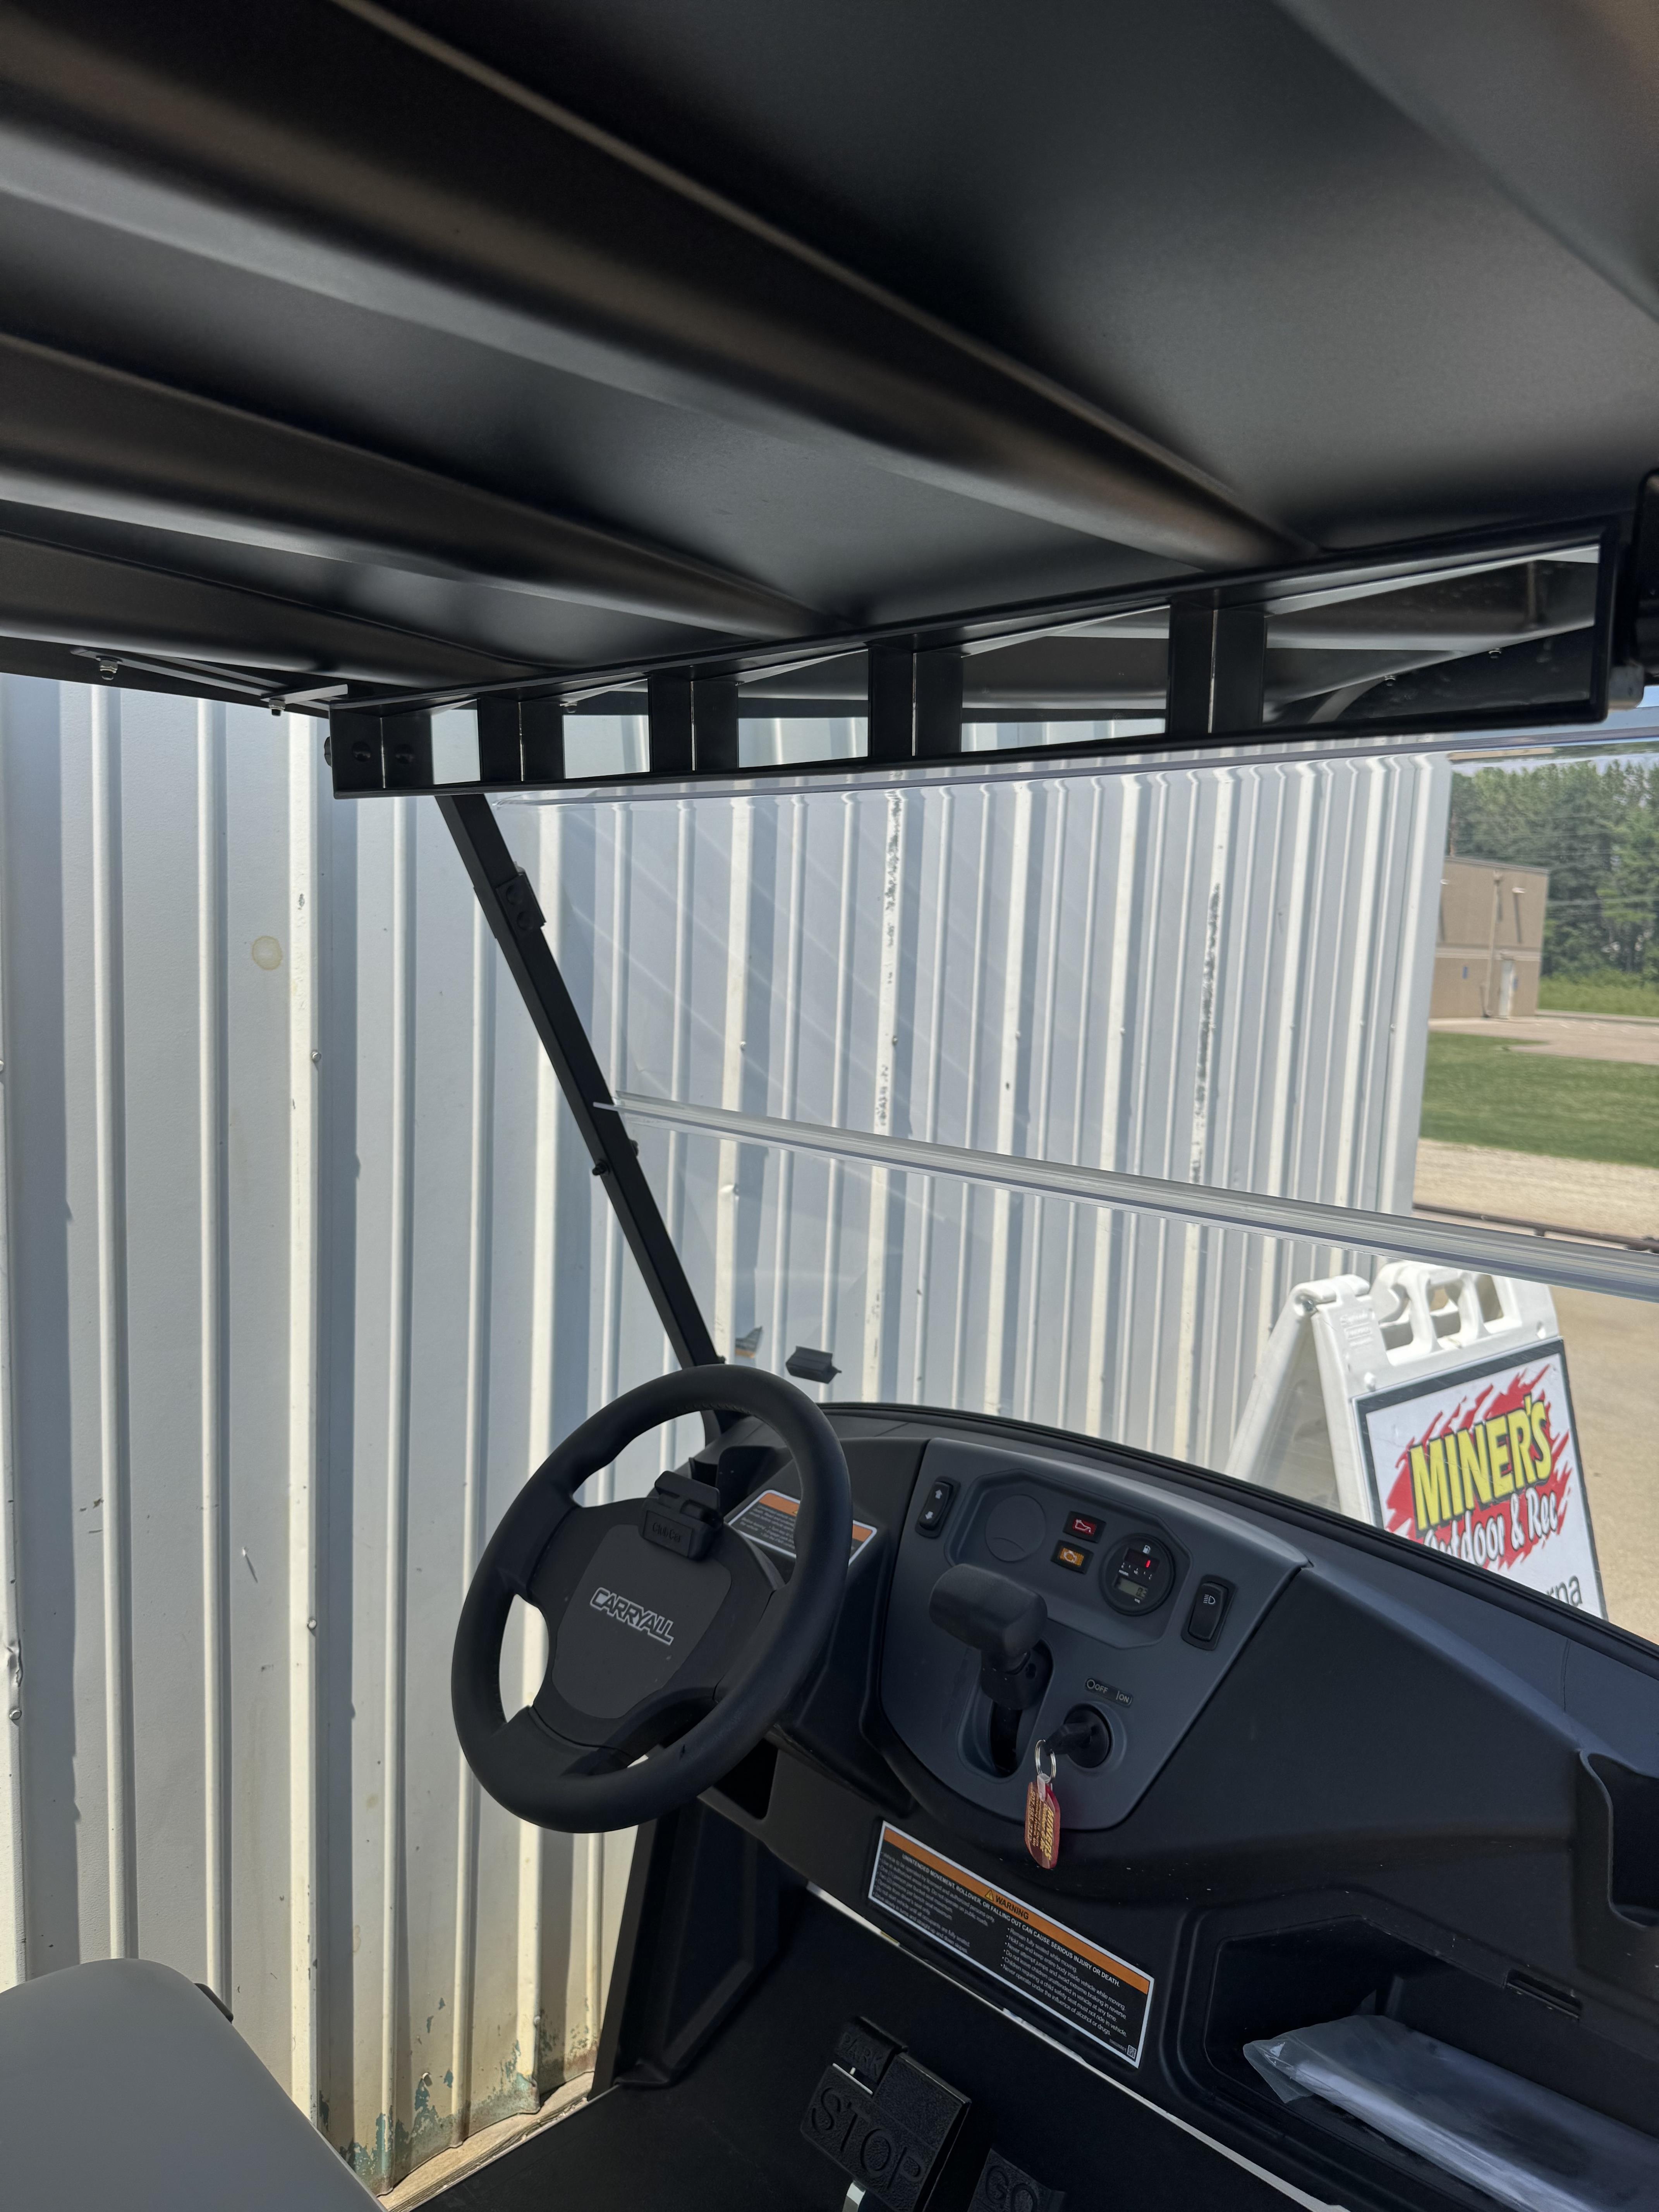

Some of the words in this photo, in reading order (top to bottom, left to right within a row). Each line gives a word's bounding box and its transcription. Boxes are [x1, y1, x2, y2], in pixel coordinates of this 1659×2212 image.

[1408, 1393, 1554, 1533] MINER'S
[653, 1522, 668, 1537] Club
[669, 1529, 682, 1543] Car
[1511, 1493, 1525, 1550] &
[1525, 1487, 1558, 1542] Rec
[589, 1587, 674, 1645] CARRYALL
[1094, 1683, 1109, 1694] OFF
[1119, 1693, 1130, 1703] ON
[995, 1894, 1029, 1921] WARNING
[982, 1901, 989, 1909] OR
[990, 1905, 1010, 1922] FALLING
[1011, 1917, 1021, 1928] OUT
[1022, 1924, 1032, 1935] CAN
[1033, 1931, 1050, 1945] CAUSE
[1051, 1941, 1073, 1959] SERIOUS
[1073, 1954, 1092, 1970] INJURY
[1092, 1966, 1101, 1975] OR
[1101, 1971, 1120, 1987] DEATH.
[841, 2032, 884, 2078] PARK
[811, 2086, 922, 2190] STOP
[985, 2164, 1039, 2212] GO
